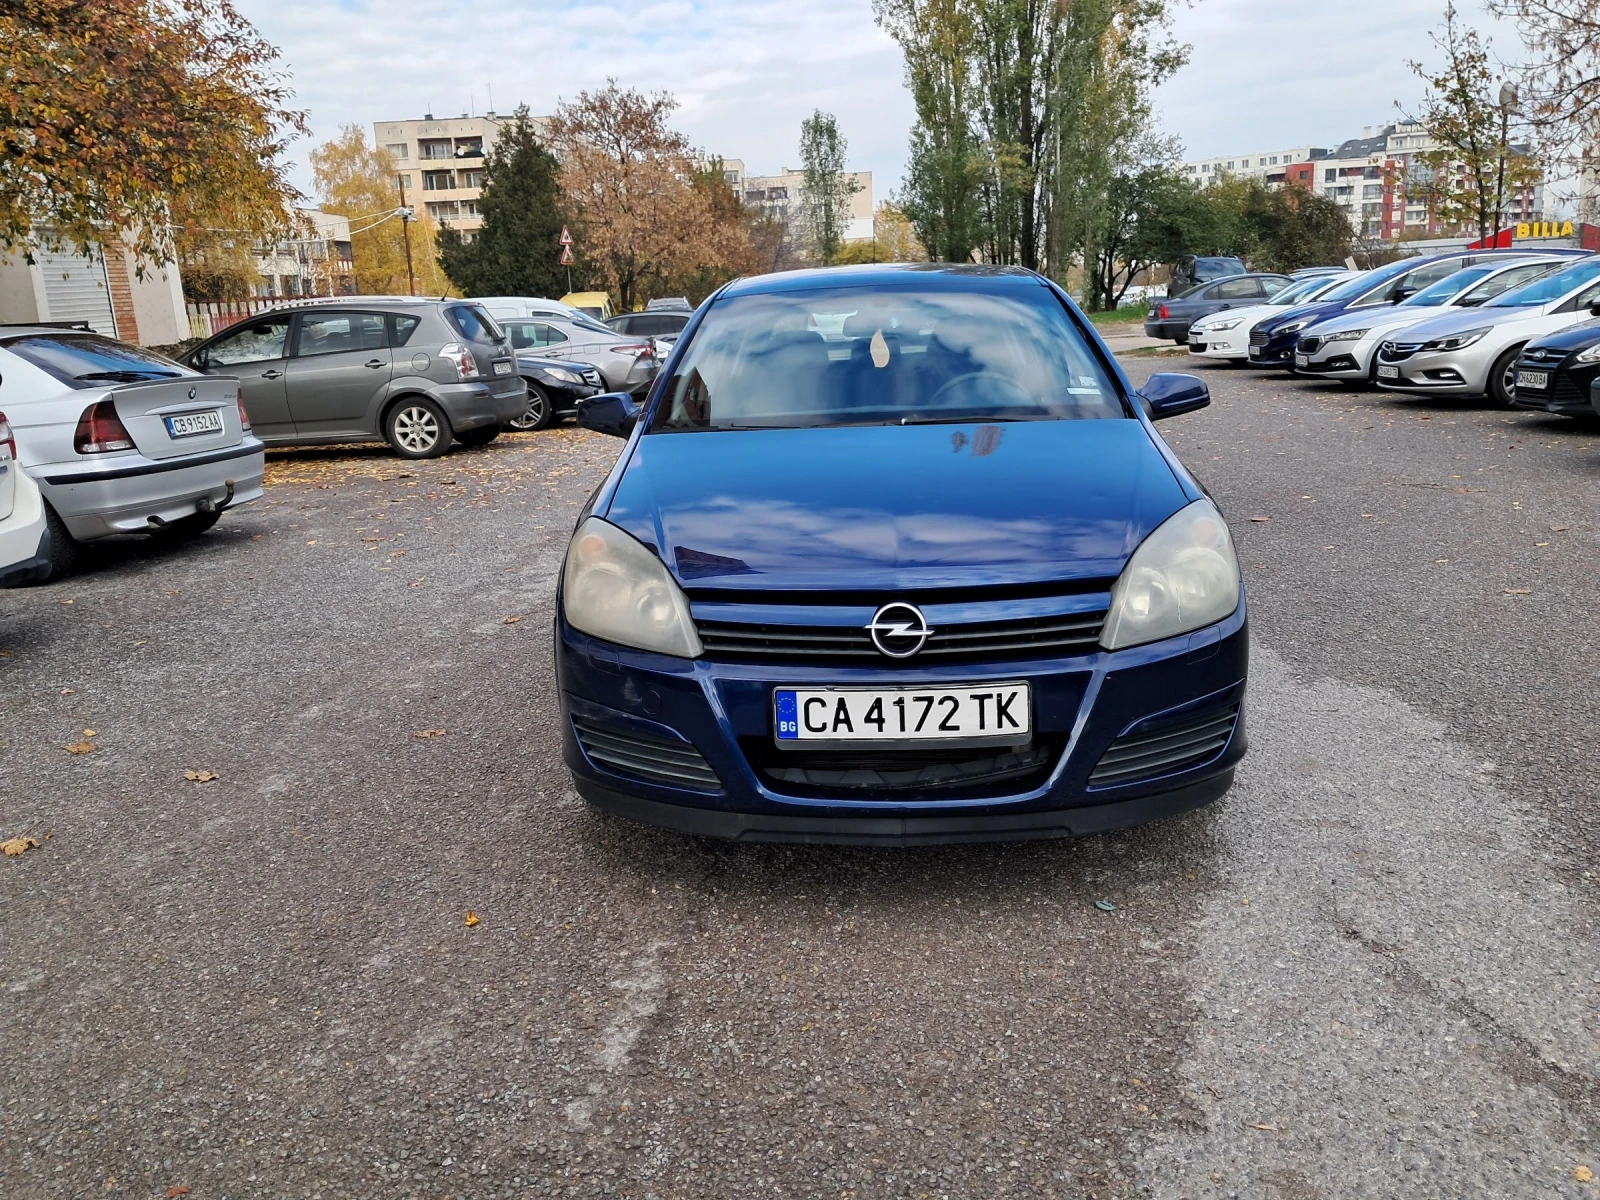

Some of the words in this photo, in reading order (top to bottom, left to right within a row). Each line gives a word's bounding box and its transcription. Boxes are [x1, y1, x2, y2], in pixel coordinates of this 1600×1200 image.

[1516, 221, 1574, 238] BILLA
[1526, 373, 1539, 384] 6230
[1539, 374, 1546, 385] BA
[174, 418, 187, 433] CB
[187, 415, 209, 431] 9152
[208, 413, 219, 428] AA
[803, 696, 854, 732] CA
[863, 695, 961, 732] 4172
[969, 691, 1020, 730] TK
[780, 721, 796, 732] BG
